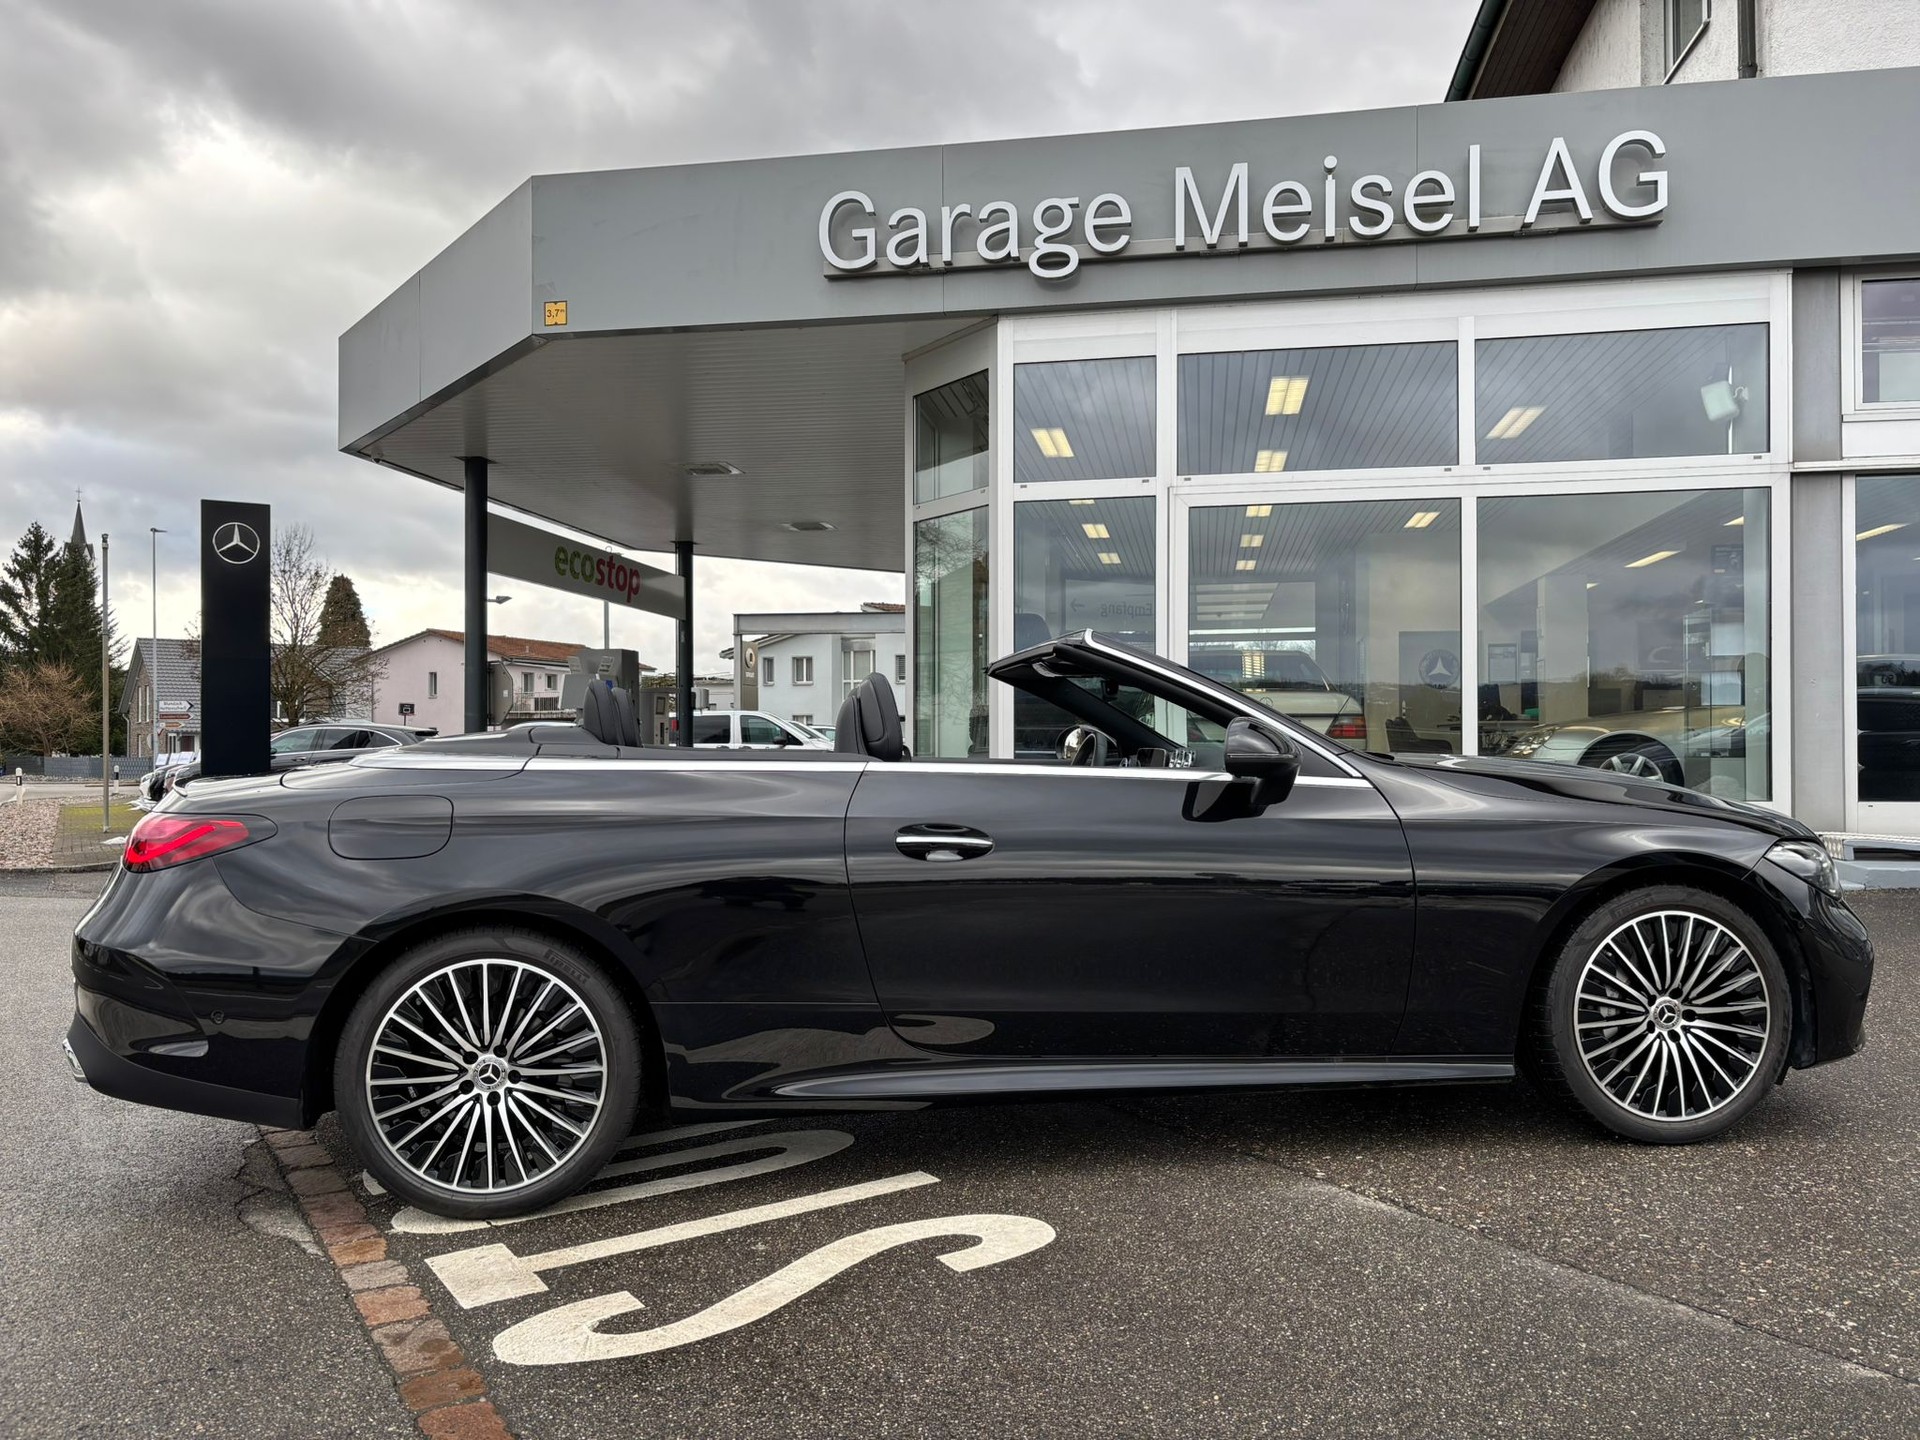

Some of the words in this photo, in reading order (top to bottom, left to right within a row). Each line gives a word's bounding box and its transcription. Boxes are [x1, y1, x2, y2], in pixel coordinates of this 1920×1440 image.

[817, 190, 1132, 281] Garage
[1174, 144, 1481, 251] Meisel
[1522, 130, 1669, 229] AG
[554, 546, 641, 603] ecostop
